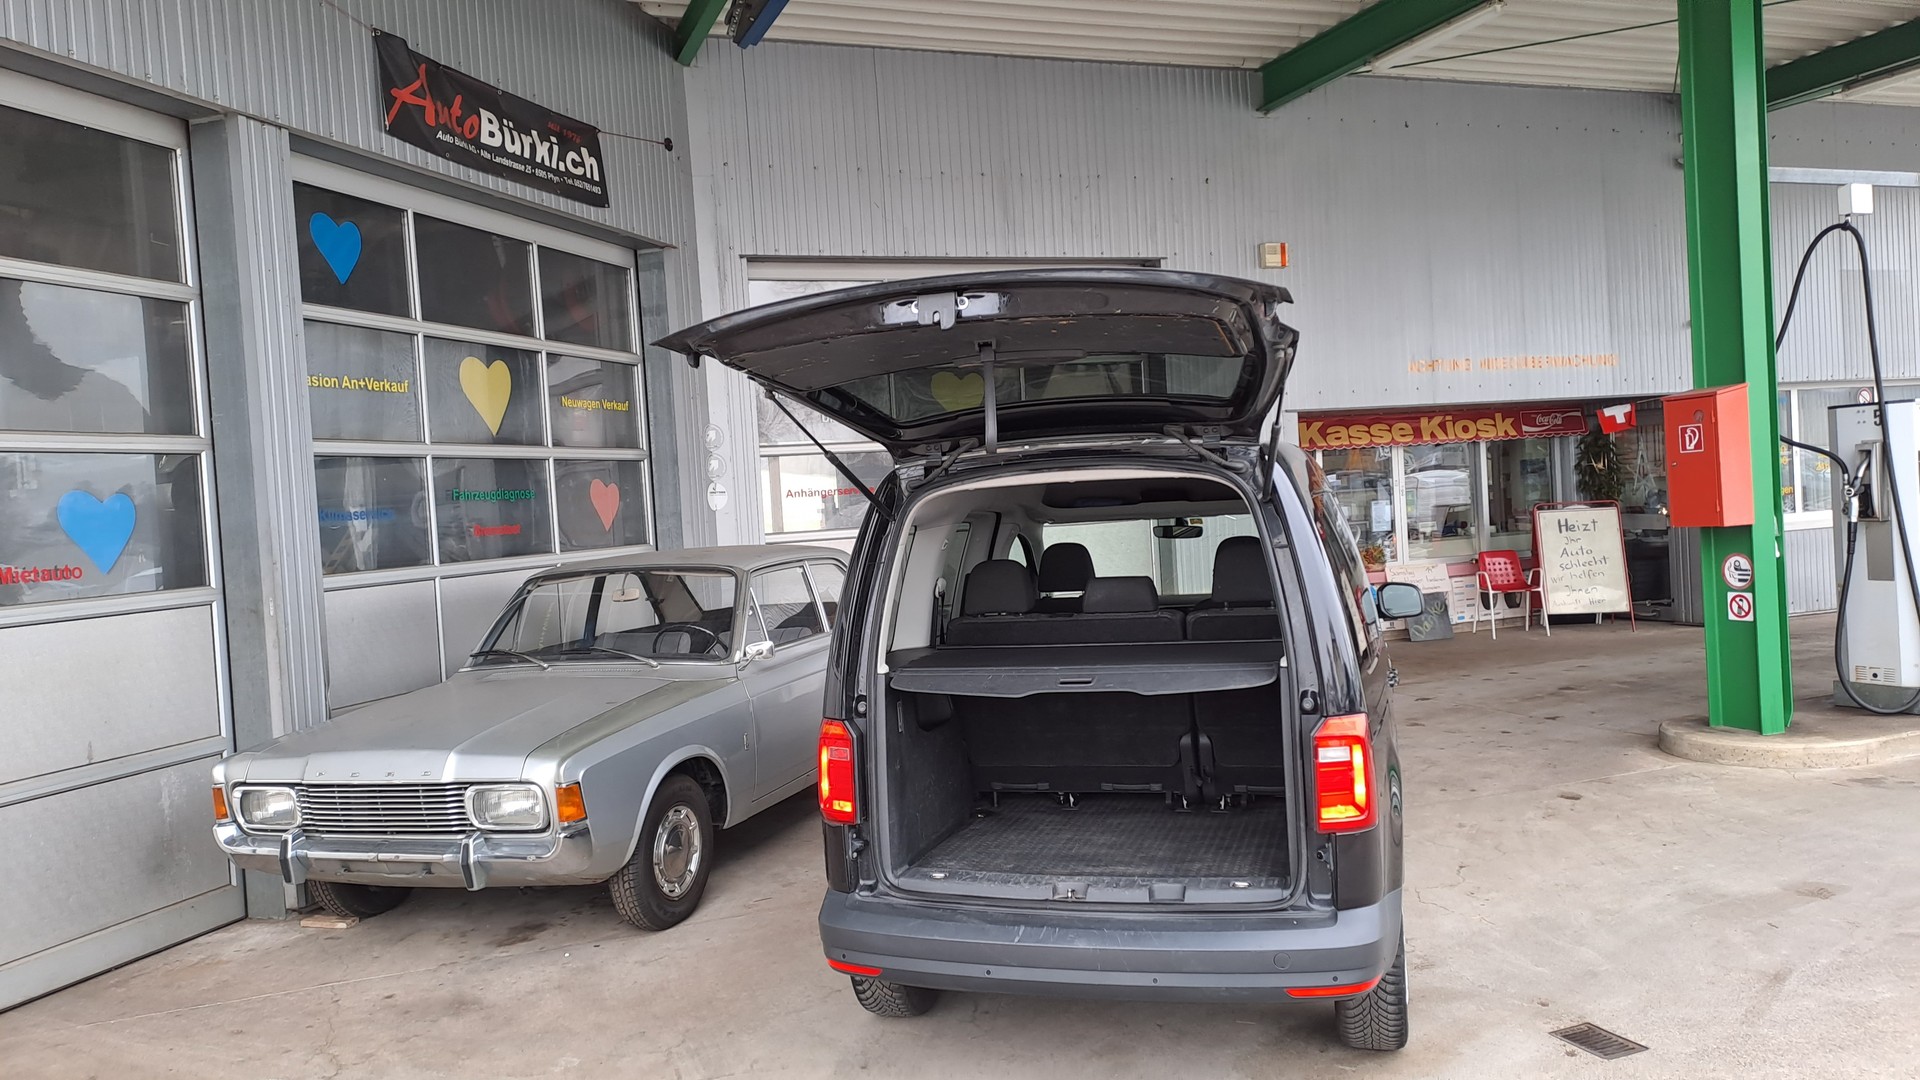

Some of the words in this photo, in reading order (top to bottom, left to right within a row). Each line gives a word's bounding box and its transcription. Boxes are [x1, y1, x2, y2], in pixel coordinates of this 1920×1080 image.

[436, 130, 454, 144] Auto
[561, 395, 600, 411] Neuwagen
[601, 398, 629, 411] Verkauf
[1299, 420, 1415, 448] Kasse
[1420, 412, 1518, 441] Kiosk
[453, 488, 535, 503] Fahrzeugdiagnose
[1557, 517, 1599, 534] Heizt
[1560, 545, 1593, 558] Auto
[1559, 555, 1609, 571] schlecht
[0, 564, 83, 585] Mietauto
[1569, 569, 1605, 580] helfen
[1411, 601, 1446, 639] Danke
